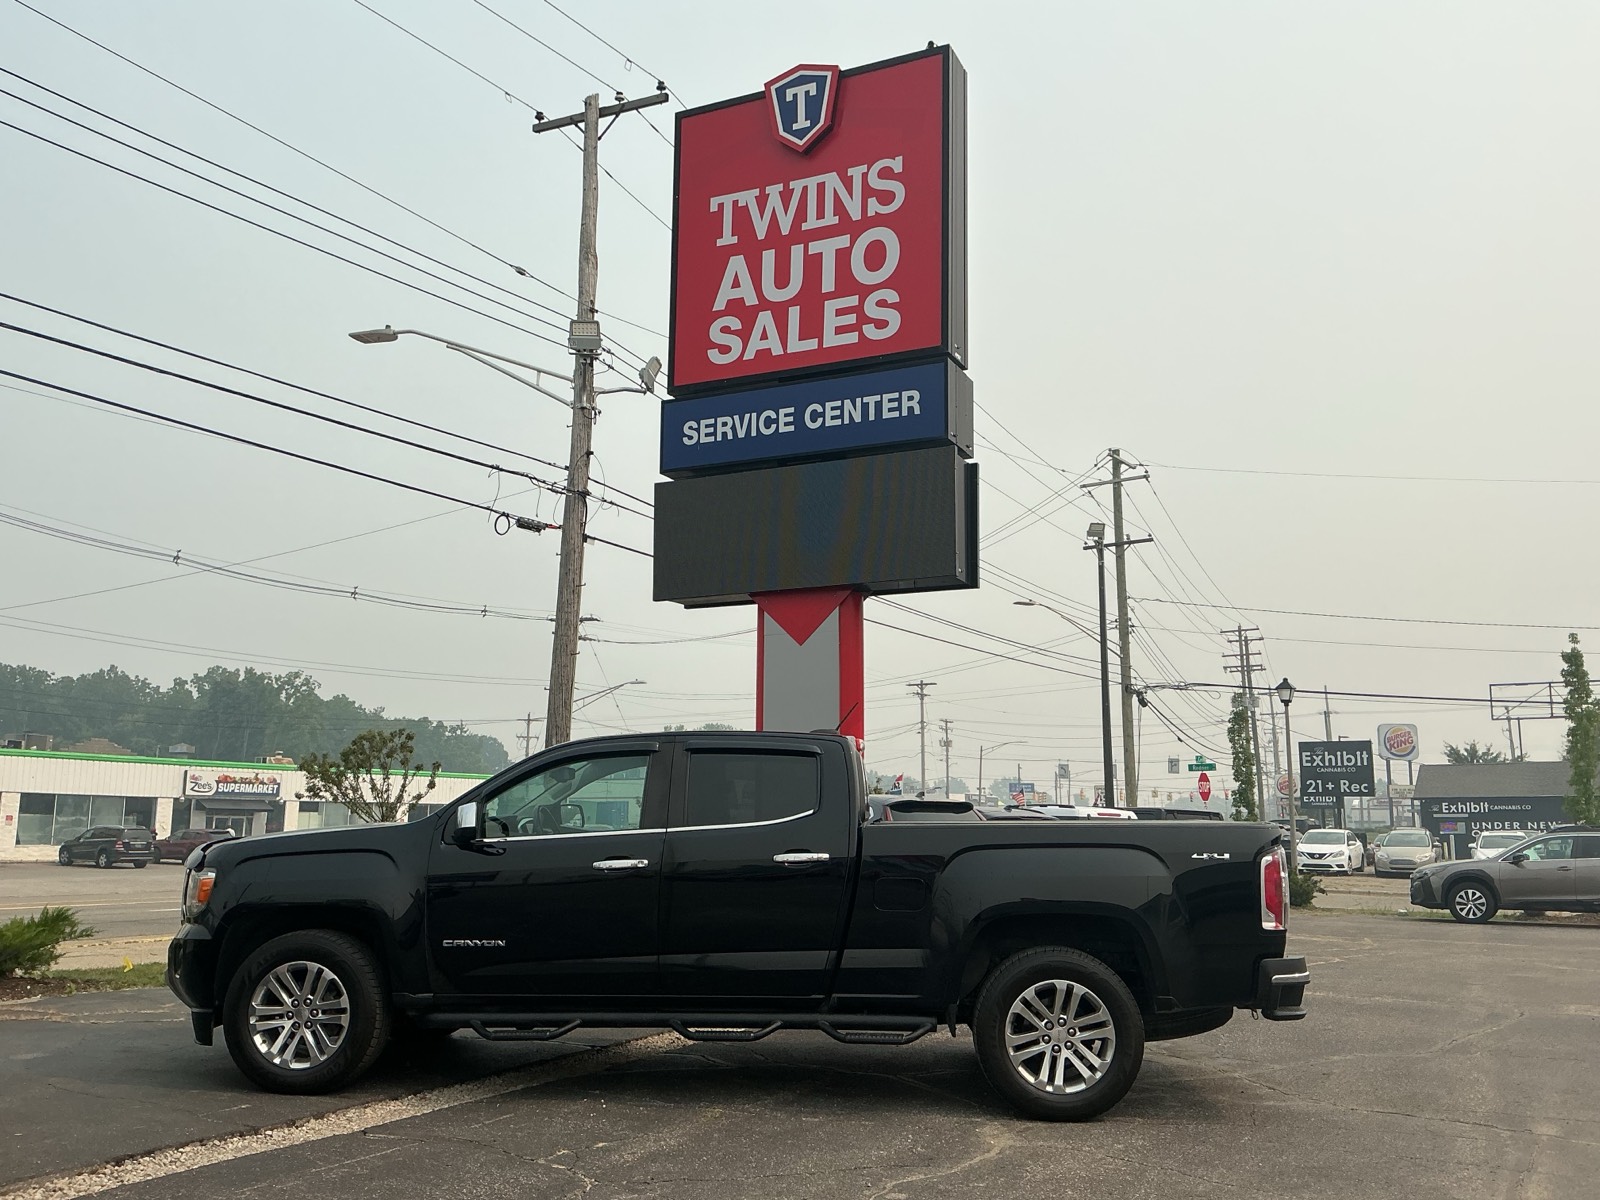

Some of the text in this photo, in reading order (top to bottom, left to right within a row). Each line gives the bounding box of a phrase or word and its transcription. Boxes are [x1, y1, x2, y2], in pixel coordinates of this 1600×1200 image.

[785, 82, 817, 131] T
[709, 155, 906, 247] TWINS
[711, 226, 901, 312] AUTO
[706, 288, 902, 365] SALES
[682, 389, 921, 446] SERVICE CENTER
[1386, 731, 1412, 743] BURGER
[1388, 736, 1414, 752] KING
[1301, 751, 1369, 767] Exhibit
[189, 781, 279, 794] Zee's SUPERMARKET
[1199, 781, 1210, 793] STOP
[1306, 779, 1335, 793] 21+
[1340, 779, 1369, 793] Rec
[1442, 802, 1489, 813] Exhibit
[1471, 821, 1521, 830] UNDER
[442, 939, 506, 947] CANYON
